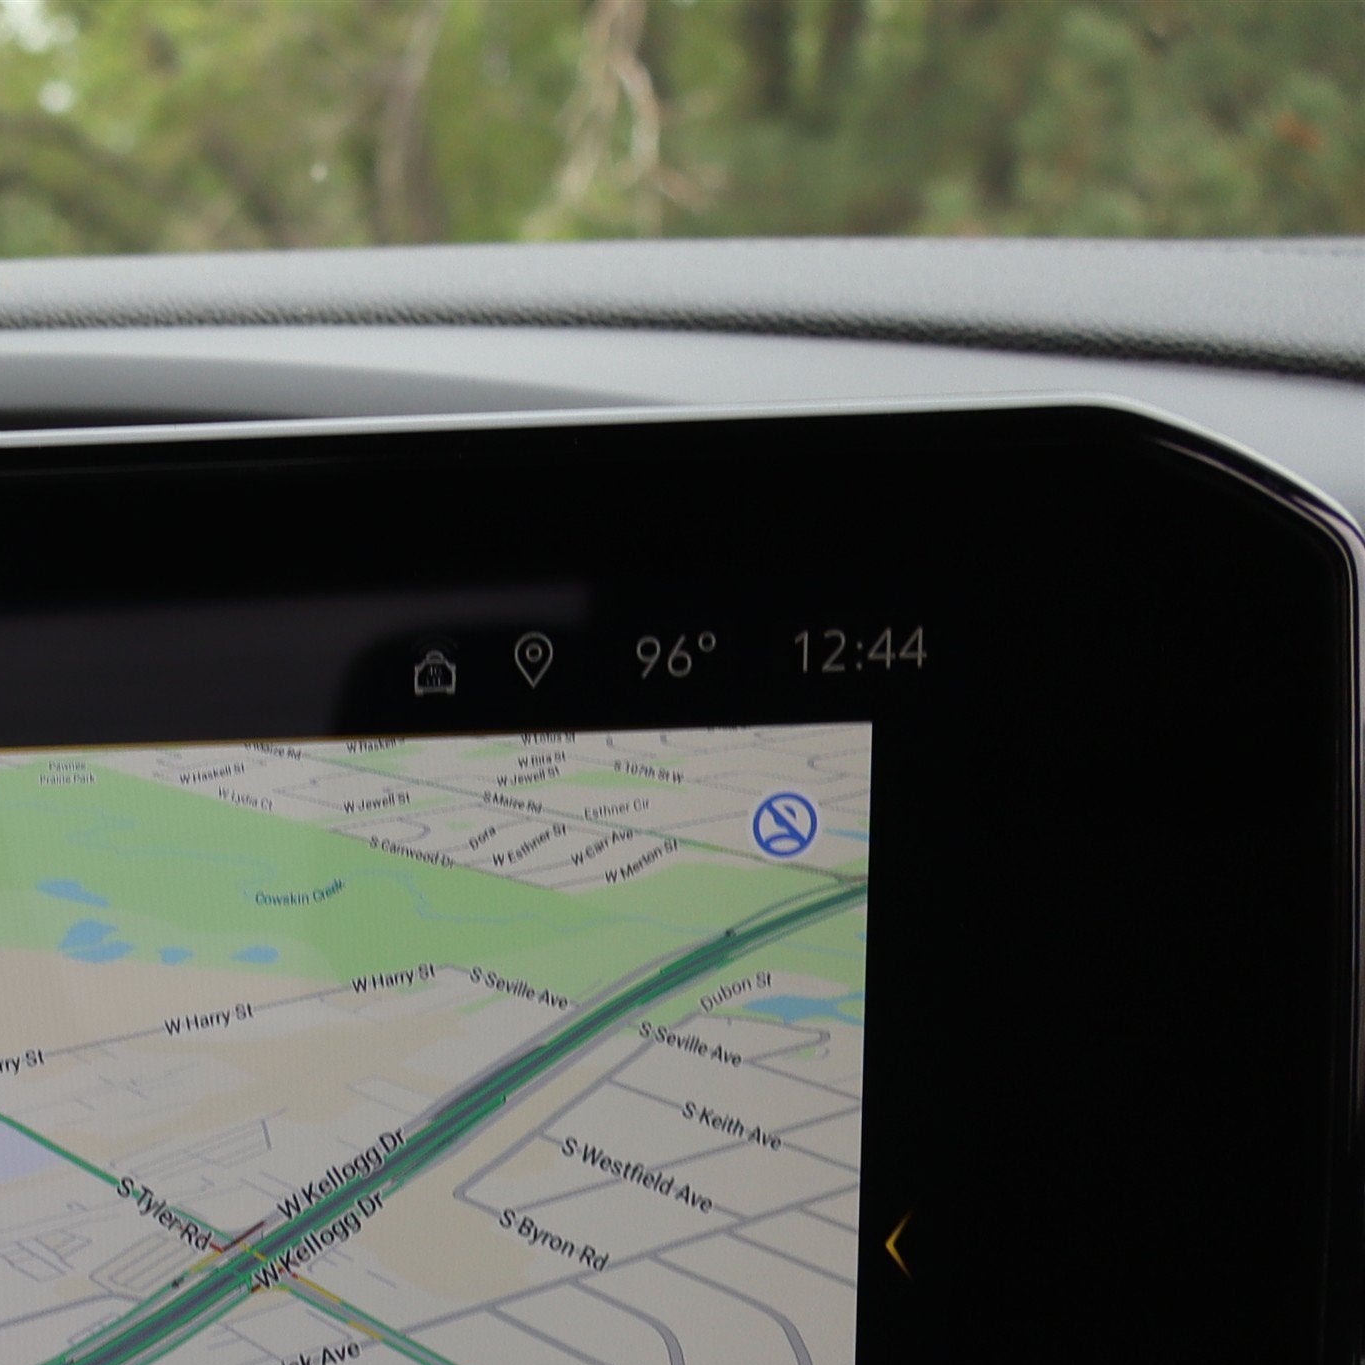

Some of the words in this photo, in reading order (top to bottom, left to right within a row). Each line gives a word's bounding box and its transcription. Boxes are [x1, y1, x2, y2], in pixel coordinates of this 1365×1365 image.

[793, 626, 928, 674] 12:44
[571, 850, 585, 867] W
[604, 869, 618, 884] W
[351, 977, 367, 994] W
[372, 968, 414, 990] Harry
[418, 961, 436, 980] St
[469, 965, 483, 984] S
[484, 971, 536, 1002] Seville
[538, 988, 568, 1010] Ave
[699, 977, 752, 1013] Dubon
[756, 970, 772, 989] St
[164, 1018, 182, 1037] W
[186, 1007, 232, 1032] Harry
[235, 1002, 254, 1020] St
[24, 1048, 45, 1067] St
[639, 1021, 652, 1039] S
[654, 1024, 709, 1057] Seville
[710, 1043, 742, 1067] Ave
[682, 1101, 696, 1120] S
[699, 1106, 745, 1138] Keith
[748, 1126, 782, 1151] Ave
[276, 1193, 303, 1221] W
[302, 1147, 385, 1207] Kellogg
[379, 1126, 408, 1156] Dr
[561, 1136, 578, 1158] S
[581, 1142, 674, 1197] Westfield
[676, 1184, 713, 1214] Ave
[117, 1176, 135, 1199] S
[135, 1188, 184, 1232] Tyler
[181, 1222, 212, 1252] Rd
[255, 1262, 281, 1291] W
[278, 1214, 362, 1276] Kellogg
[357, 1191, 385, 1221] Dr
[499, 1208, 516, 1229] S
[518, 1215, 575, 1257] Byron
[577, 1244, 610, 1272] Rd
